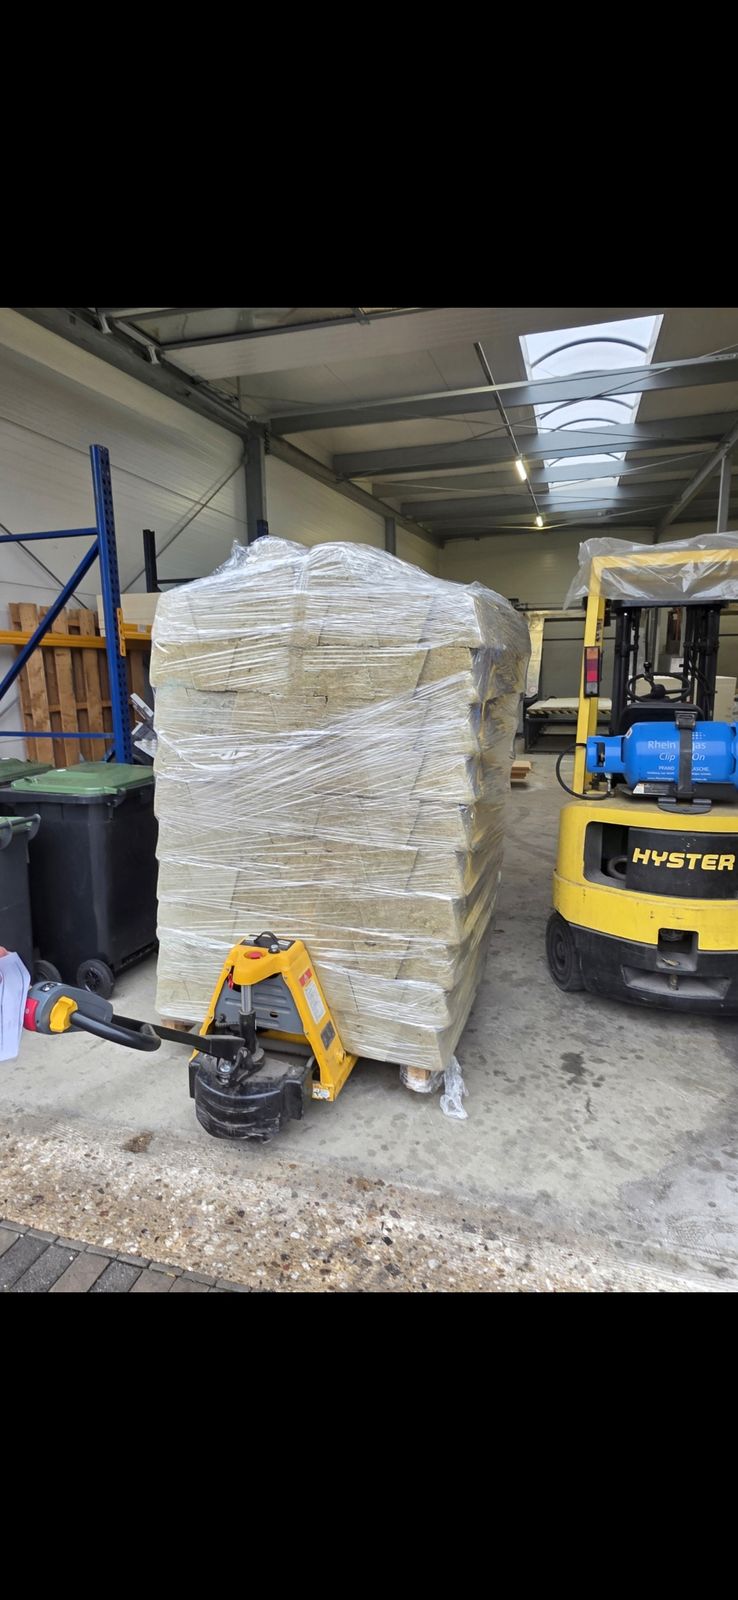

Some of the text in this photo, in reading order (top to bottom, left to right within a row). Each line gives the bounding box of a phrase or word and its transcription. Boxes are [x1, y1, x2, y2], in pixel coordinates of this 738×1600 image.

[647, 740, 676, 750] Rhein
[659, 752, 705, 762] Clip On
[632, 847, 736, 871] HYSTER
